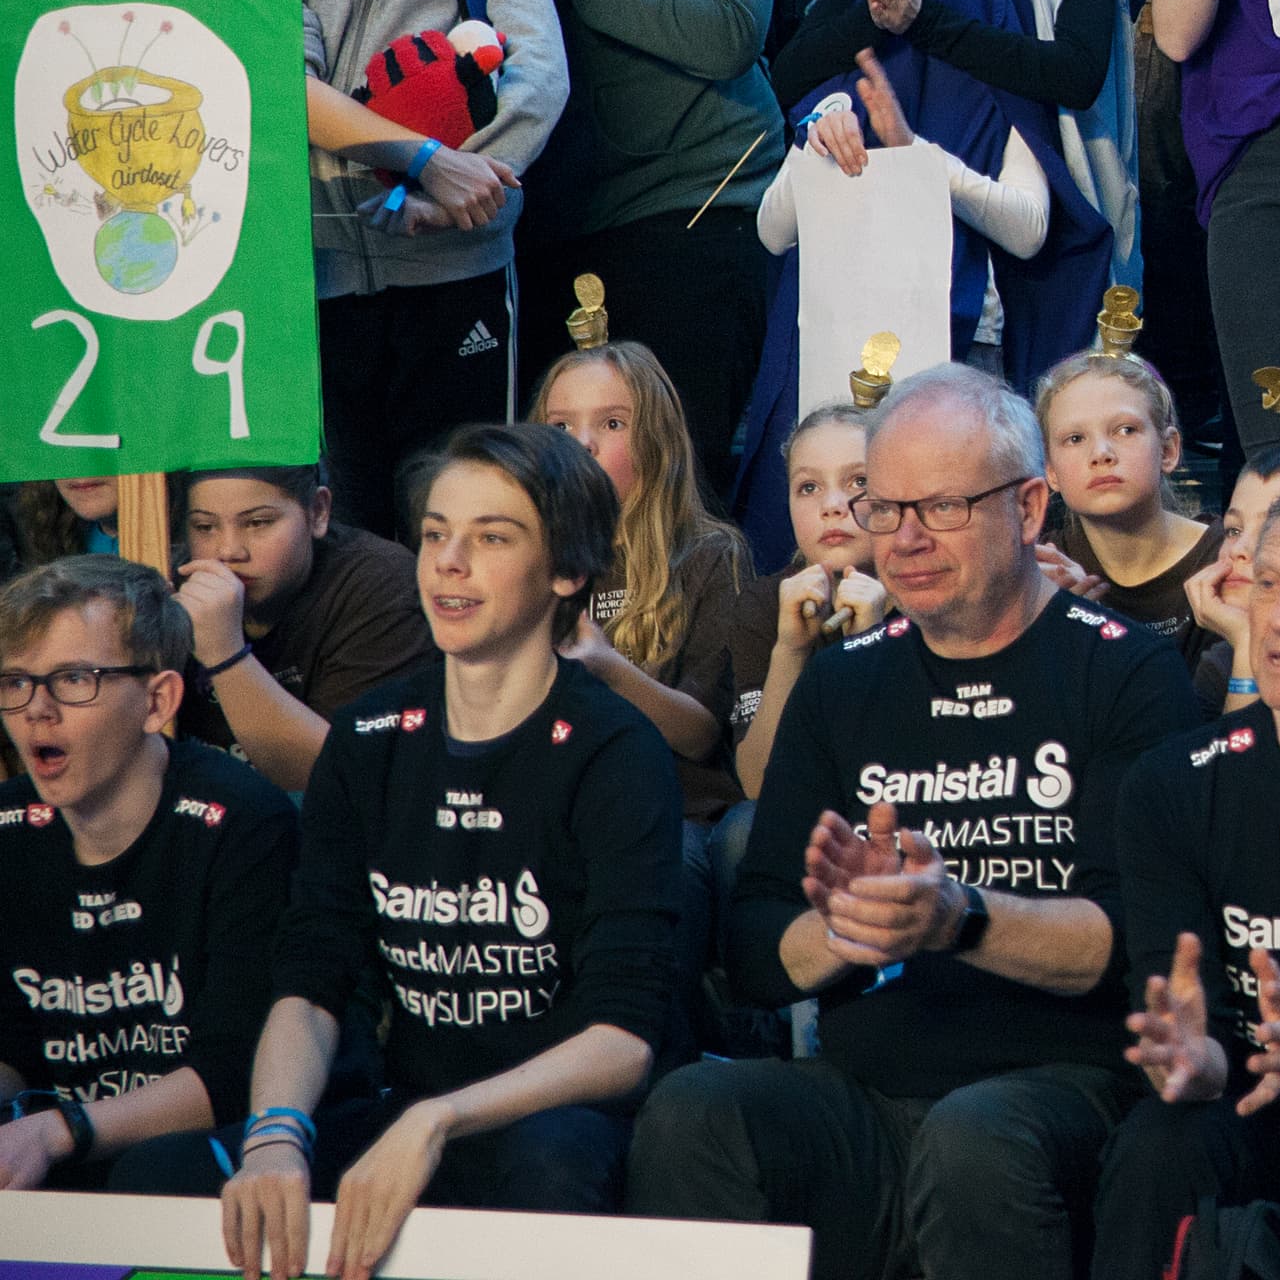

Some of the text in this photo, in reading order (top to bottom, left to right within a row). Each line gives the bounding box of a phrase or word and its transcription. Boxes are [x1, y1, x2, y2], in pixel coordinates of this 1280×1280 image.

[32, 107, 245, 174] Water Cycle Lovers
[458, 336, 499, 358] adidas
[888, 618, 910, 636] 24
[1103, 621, 1125, 639] 24
[956, 683, 993, 700] TEAM
[931, 697, 1015, 719] FED GED
[403, 711, 426, 728] 24
[1230, 730, 1254, 749] 24
[855, 756, 1018, 806] Sanistål
[446, 791, 484, 806] TEAM
[27, 804, 54, 822] 24
[944, 857, 1075, 890] SUPPLY
[368, 870, 508, 926] Sanistål
